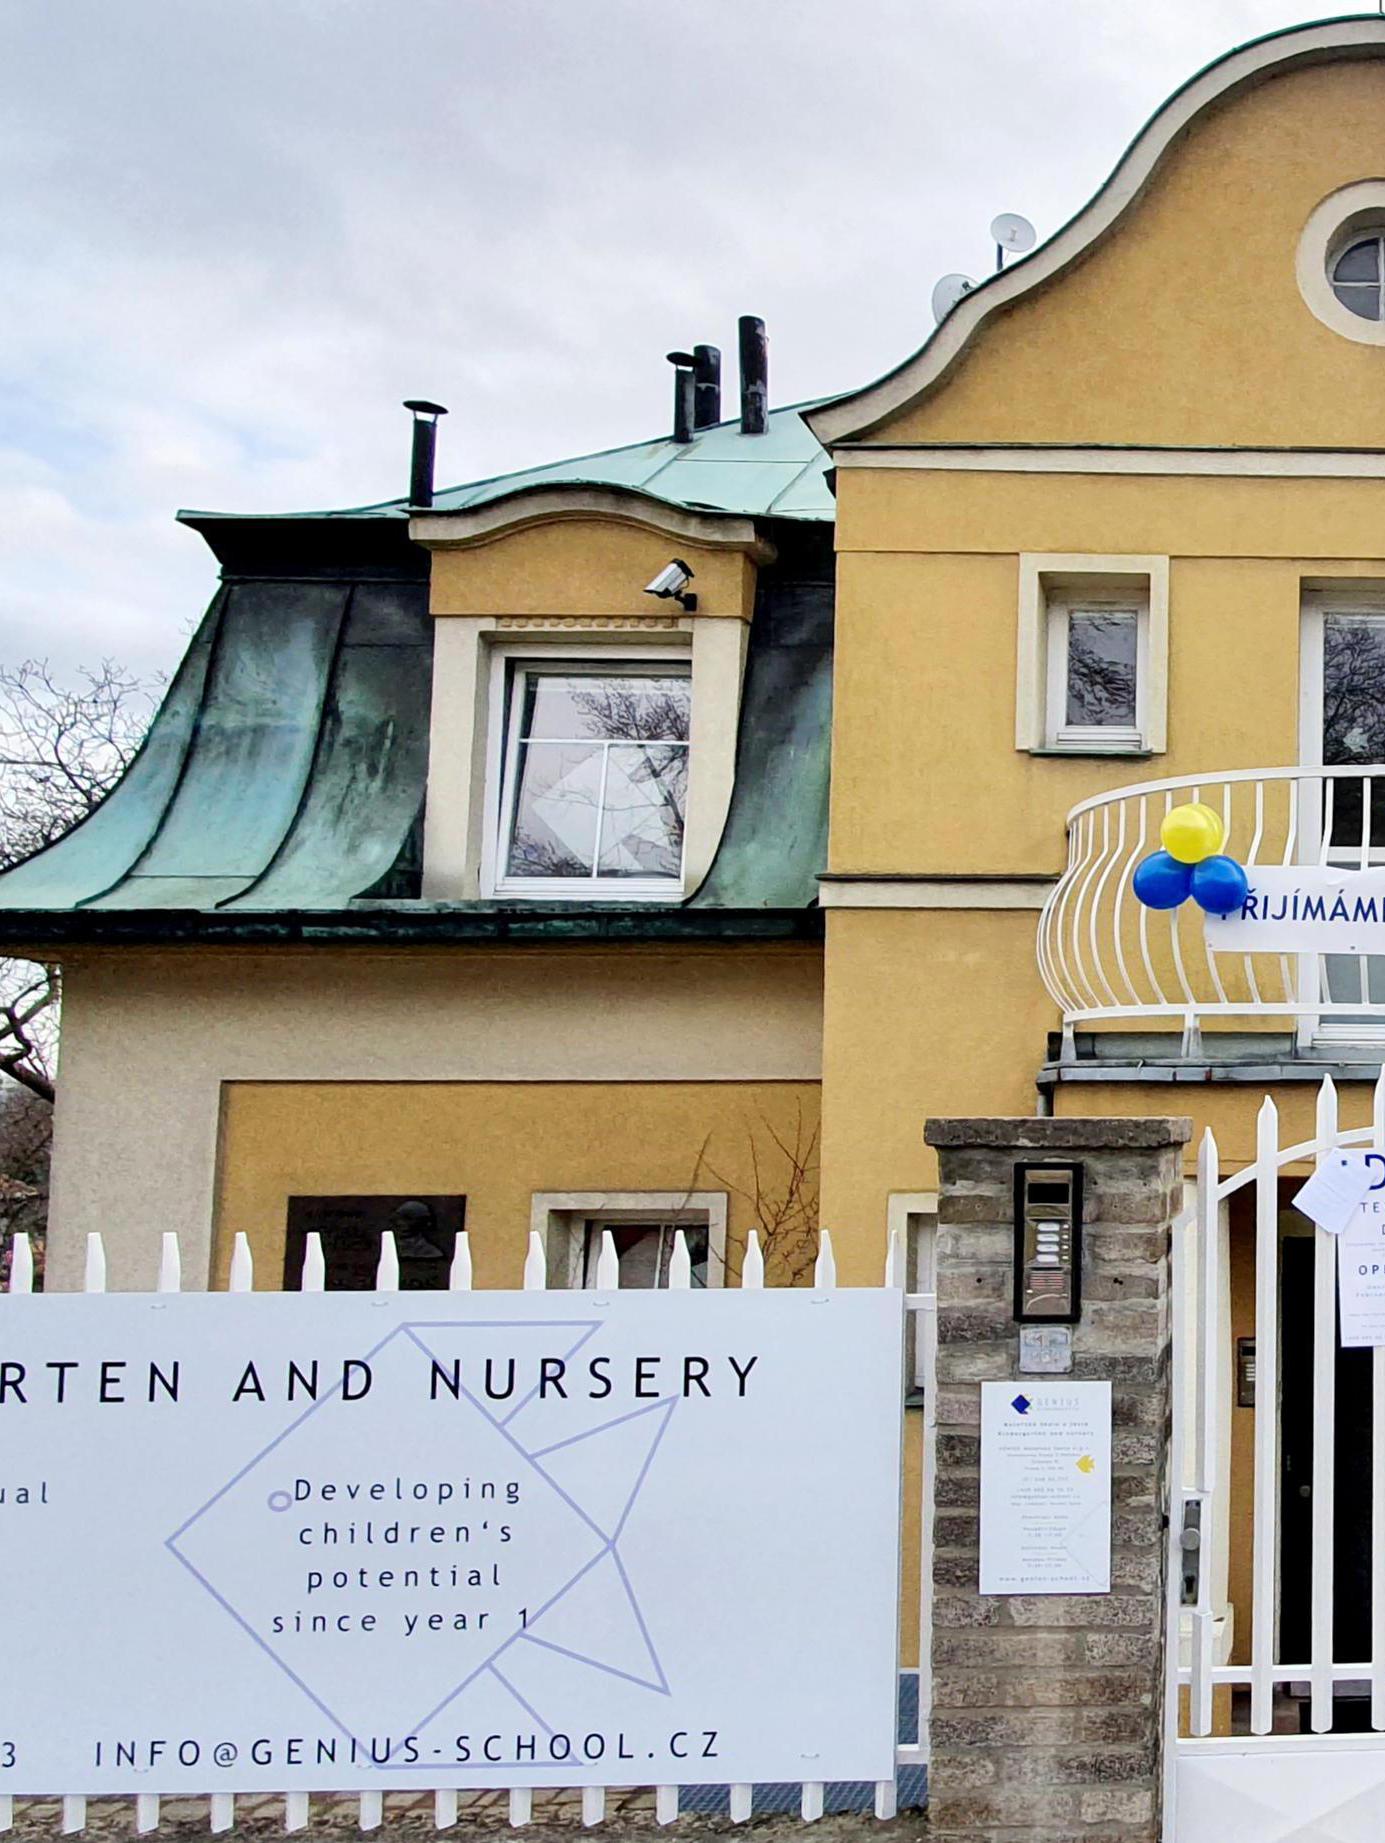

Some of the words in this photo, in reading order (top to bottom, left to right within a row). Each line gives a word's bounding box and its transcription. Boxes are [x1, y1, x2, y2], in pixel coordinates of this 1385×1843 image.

[232, 1359, 373, 1402] AND
[430, 1356, 759, 1400] NURSERY
[294, 1477, 520, 1505] Developing
[307, 1563, 500, 1593] potential
[273, 1610, 378, 1633] since
[404, 1612, 491, 1637] year
[518, 1608, 528, 1630] 1
[1, 1741, 17, 1768] 3
[95, 1731, 720, 1768] INFO@GENIUS-SCHOOL.CZ
